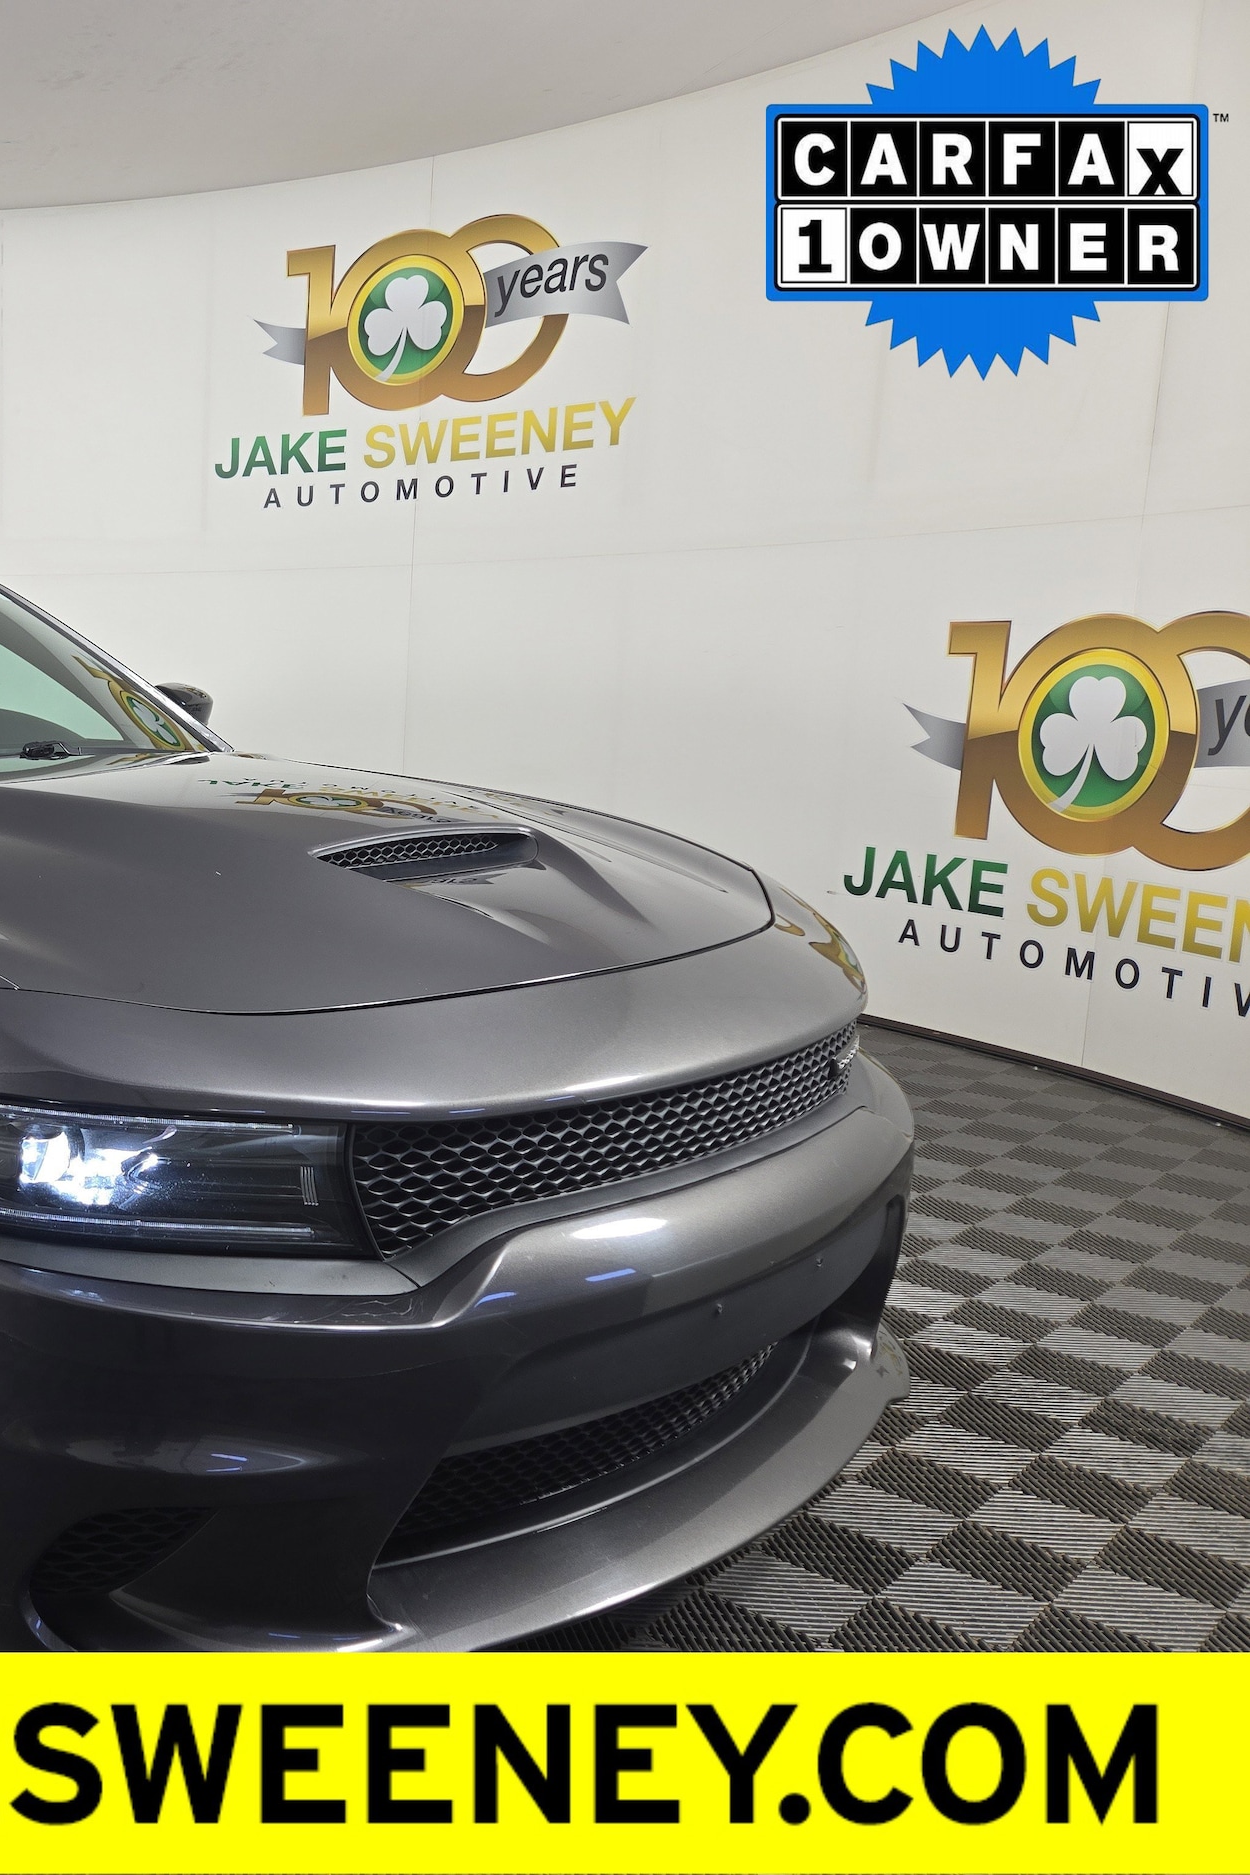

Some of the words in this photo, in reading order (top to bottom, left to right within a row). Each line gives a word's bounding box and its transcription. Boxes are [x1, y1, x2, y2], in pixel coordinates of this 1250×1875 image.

[286, 213, 569, 416] 100
[494, 252, 609, 318] years
[214, 429, 347, 479] JAKE
[363, 396, 637, 469] SWEENEY
[263, 463, 578, 509] AUTOMOTIVE
[843, 846, 1009, 918] JAKE
